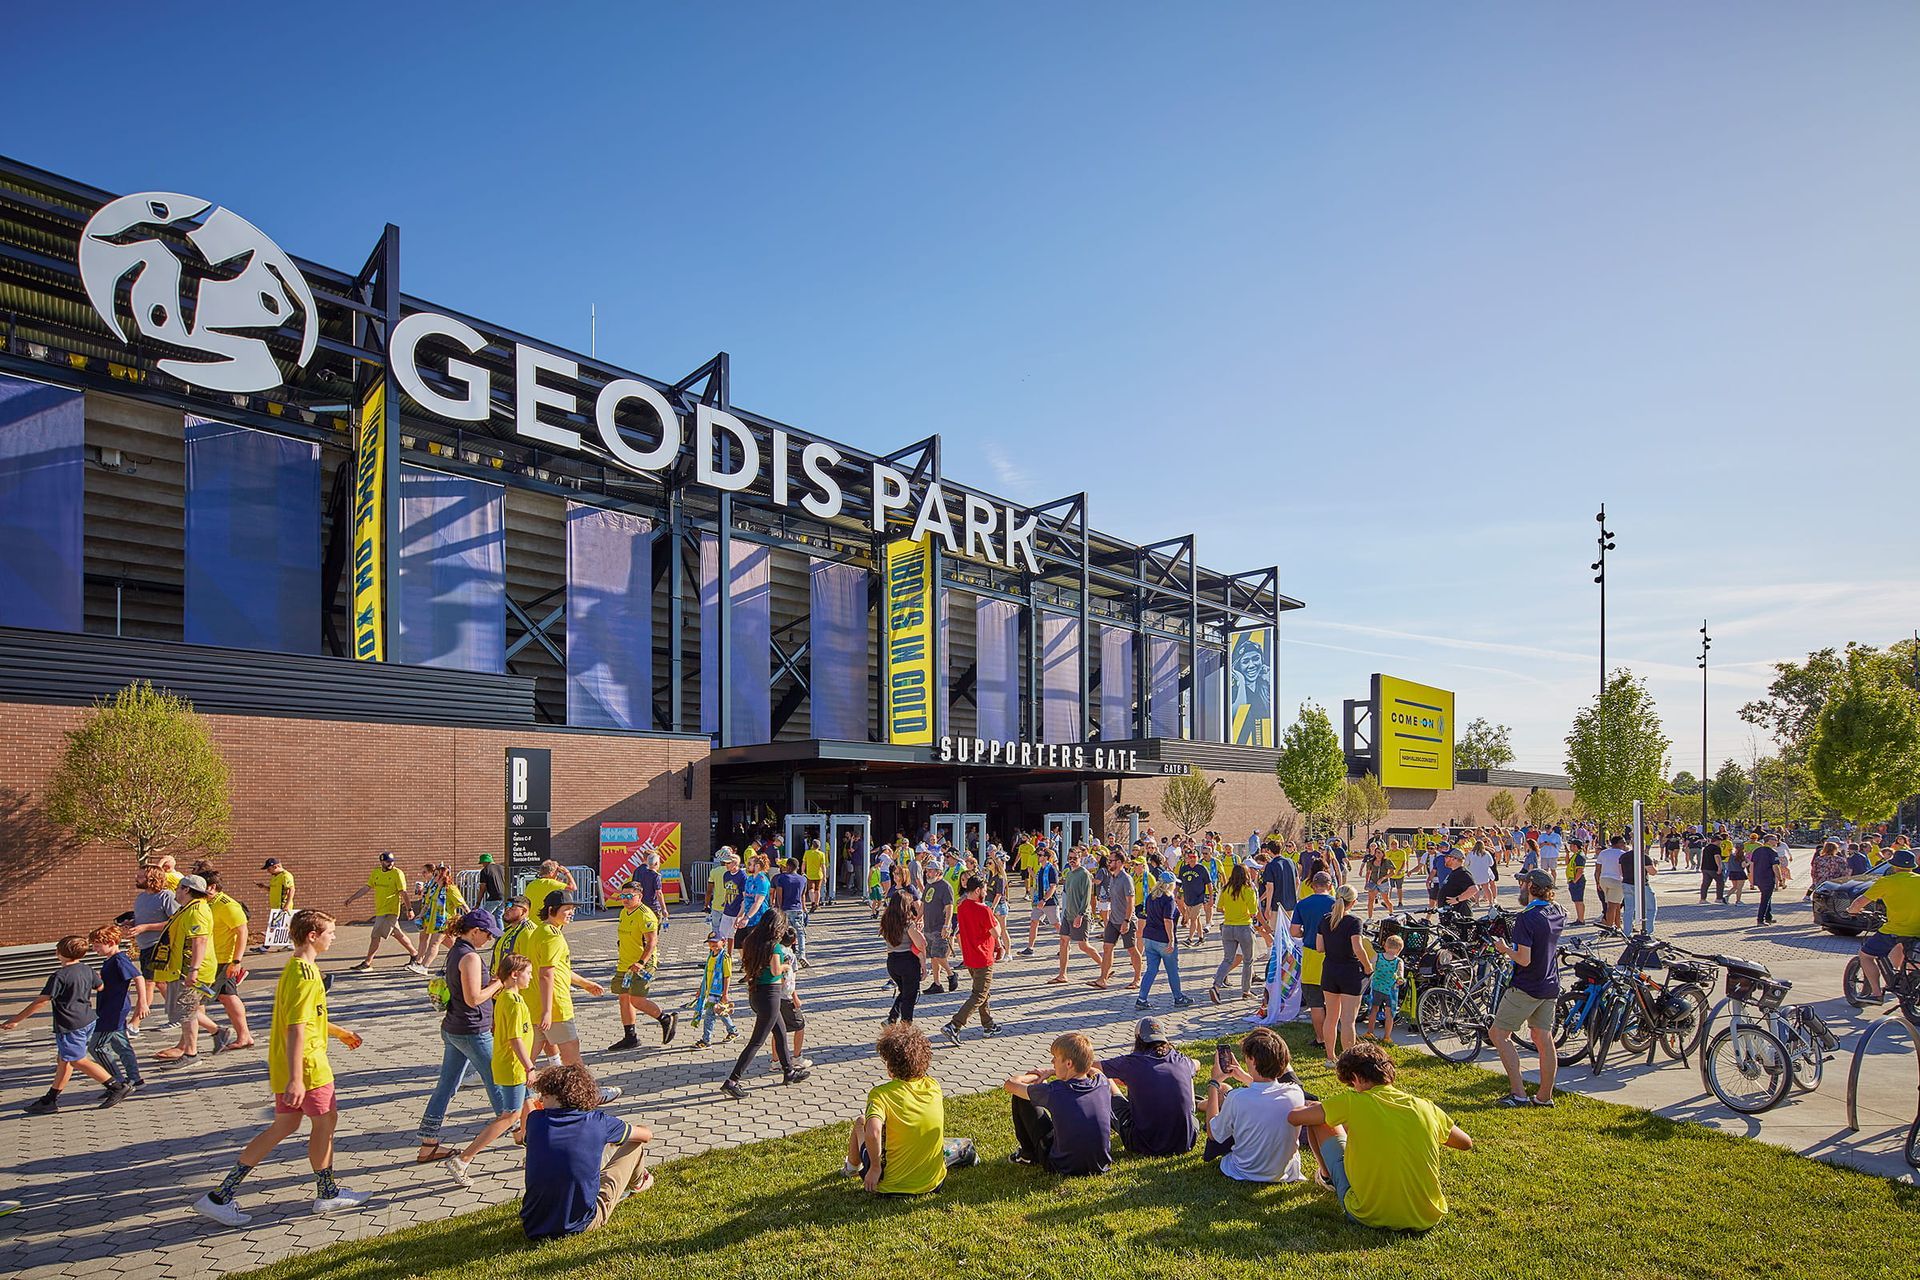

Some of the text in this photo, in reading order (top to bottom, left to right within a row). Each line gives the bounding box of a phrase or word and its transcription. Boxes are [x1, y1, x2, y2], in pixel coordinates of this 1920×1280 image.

[389, 312, 1041, 575] GEODIS PARK
[356, 425, 379, 536] COME
[356, 537, 374, 598] ON
[891, 559, 927, 734] BOYS IN GOLD
[1391, 712, 1434, 728] COME ON
[940, 736, 1137, 771] SUPPORTERS GATE
[1164, 764, 1188, 774] GATE B
[512, 757, 528, 803] B
[608, 863, 633, 890] BEV
